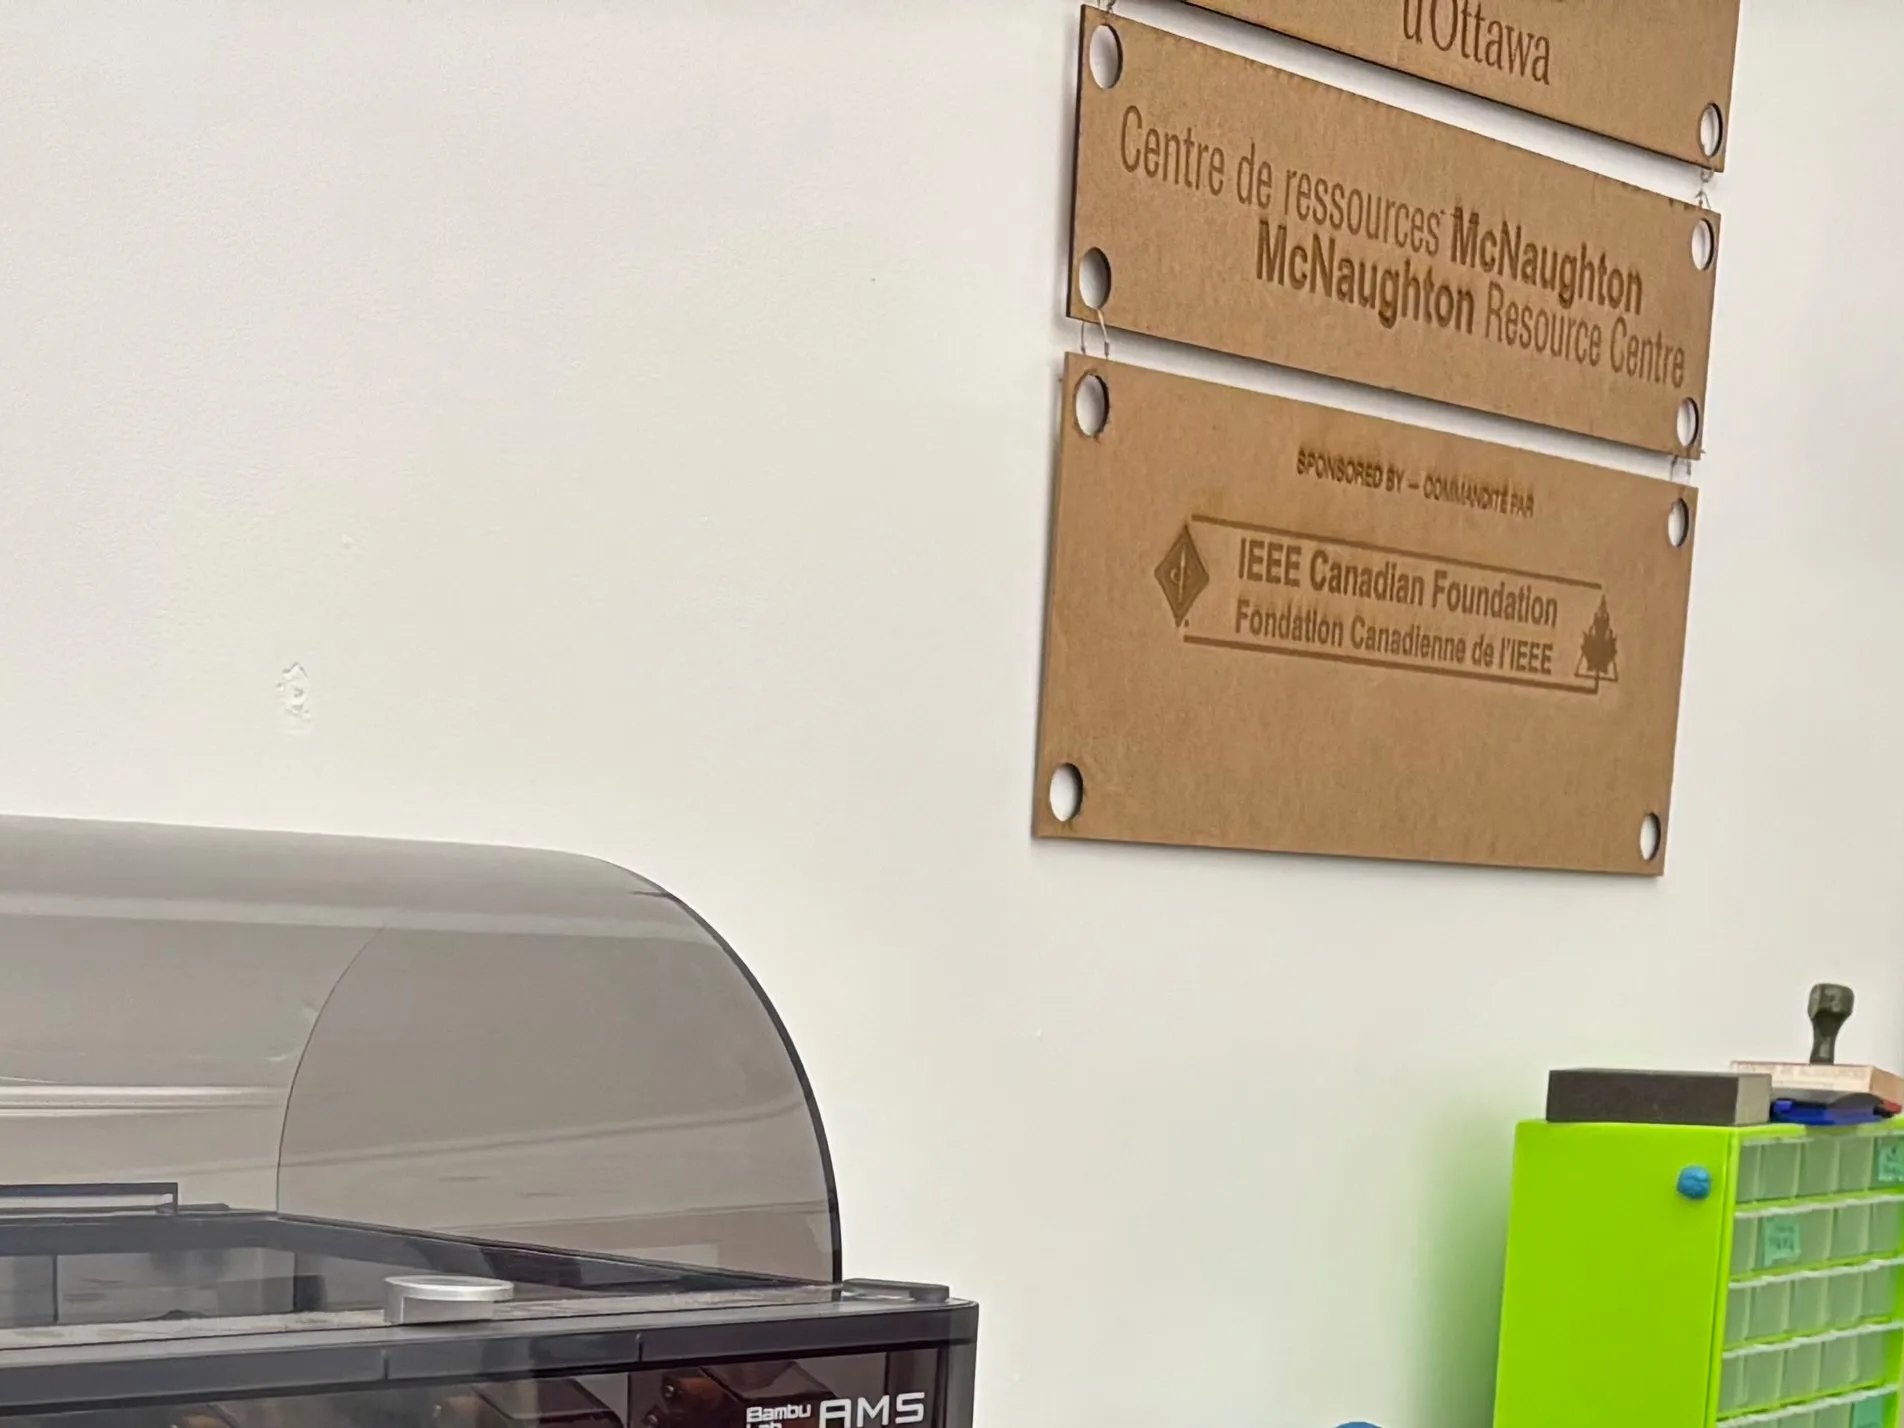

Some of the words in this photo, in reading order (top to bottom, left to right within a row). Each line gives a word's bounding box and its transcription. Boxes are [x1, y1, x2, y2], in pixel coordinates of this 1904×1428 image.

[1120, 104, 1225, 197] Centre
[1236, 141, 1273, 210] de
[1284, 168, 1440, 257] ressources
[1450, 205, 1643, 316] McNaughton
[1256, 217, 1475, 330] McNaughton
[1485, 280, 1603, 368] Resource
[1609, 315, 1686, 390] Centre
[1296, 446, 1384, 490] SPONSORED
[1385, 462, 1406, 494] BY
[1509, 487, 1535, 519] PAR
[1238, 537, 1303, 588] IEEE
[1309, 548, 1425, 607] Canadian
[1431, 569, 1558, 629] Foundation
[1234, 597, 1344, 649] Fondation
[1350, 613, 1466, 664] Canadienne
[1471, 633, 1494, 670] de
[1498, 636, 1554, 676] l'IEEE
[746, 1402, 812, 1424] Bambu
